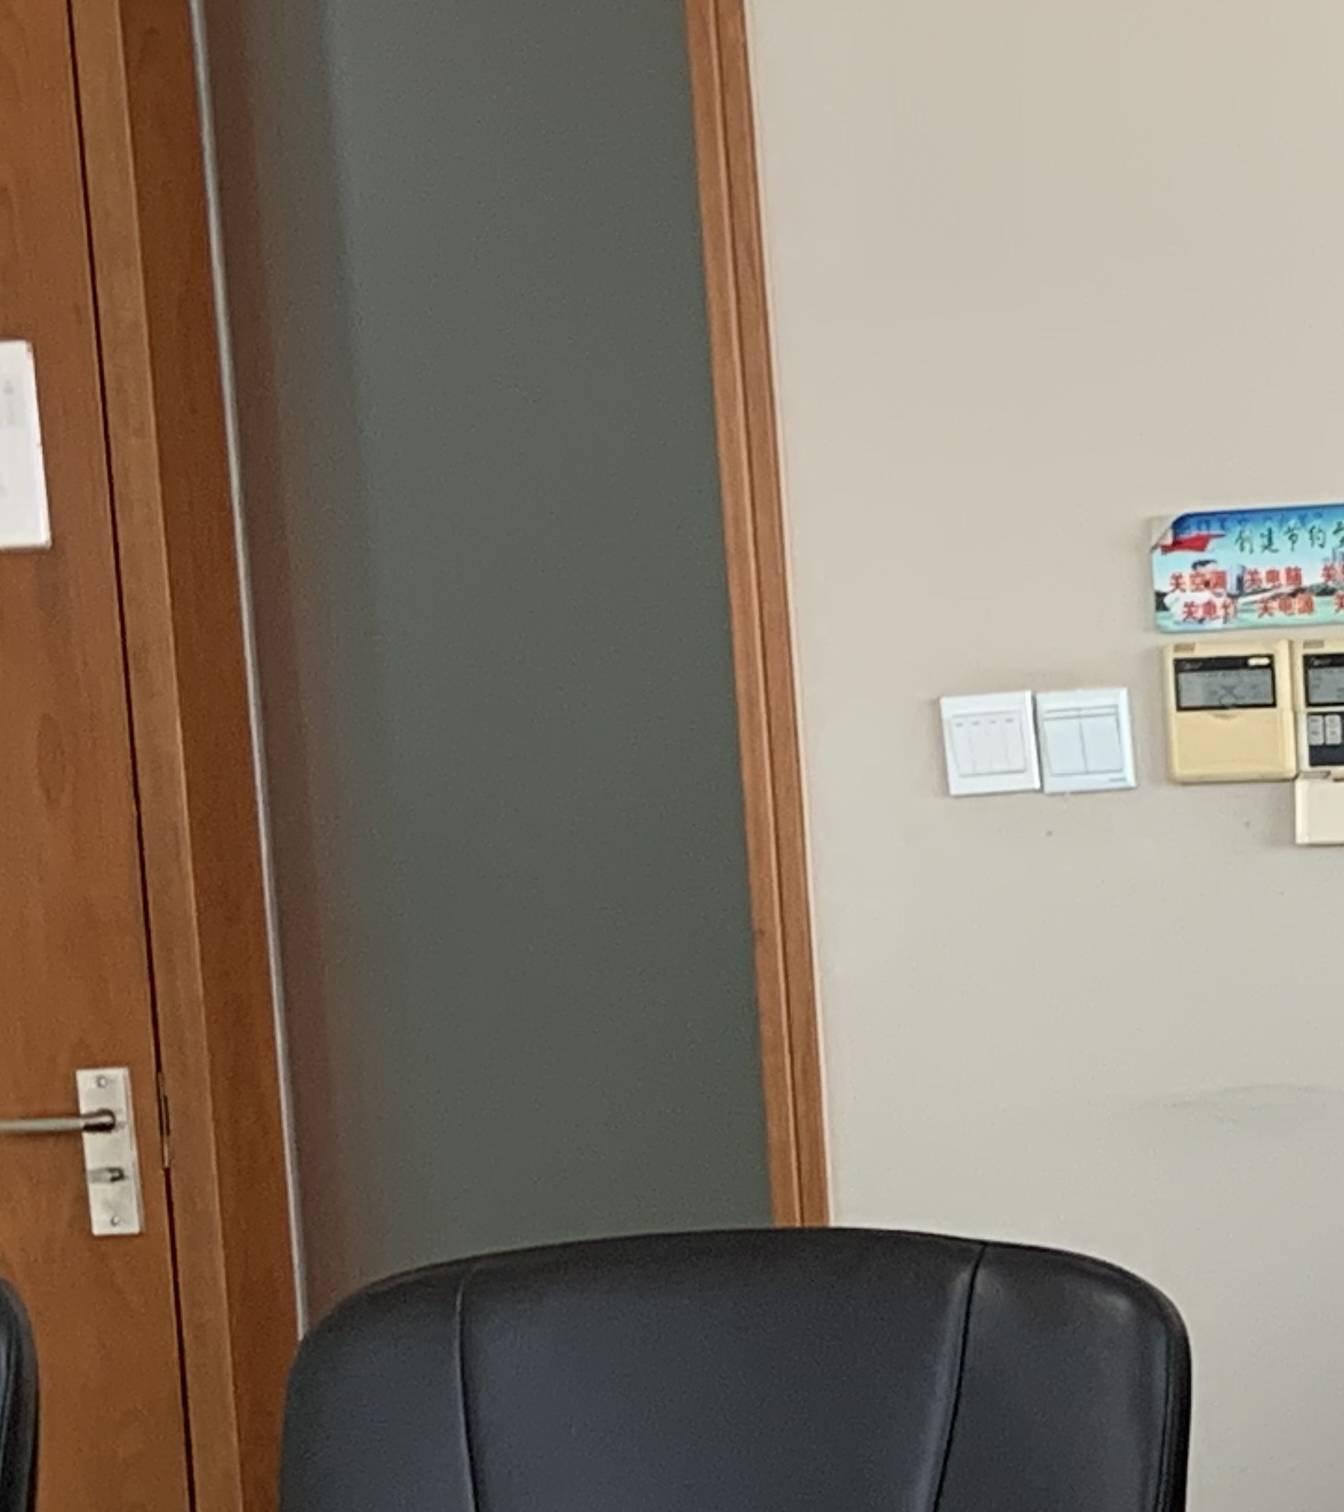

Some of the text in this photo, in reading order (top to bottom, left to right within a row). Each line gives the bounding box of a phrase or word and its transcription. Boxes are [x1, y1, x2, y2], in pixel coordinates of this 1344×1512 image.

[1244, 566, 1303, 589] 关电脑
[1256, 591, 1316, 619] 关电源
